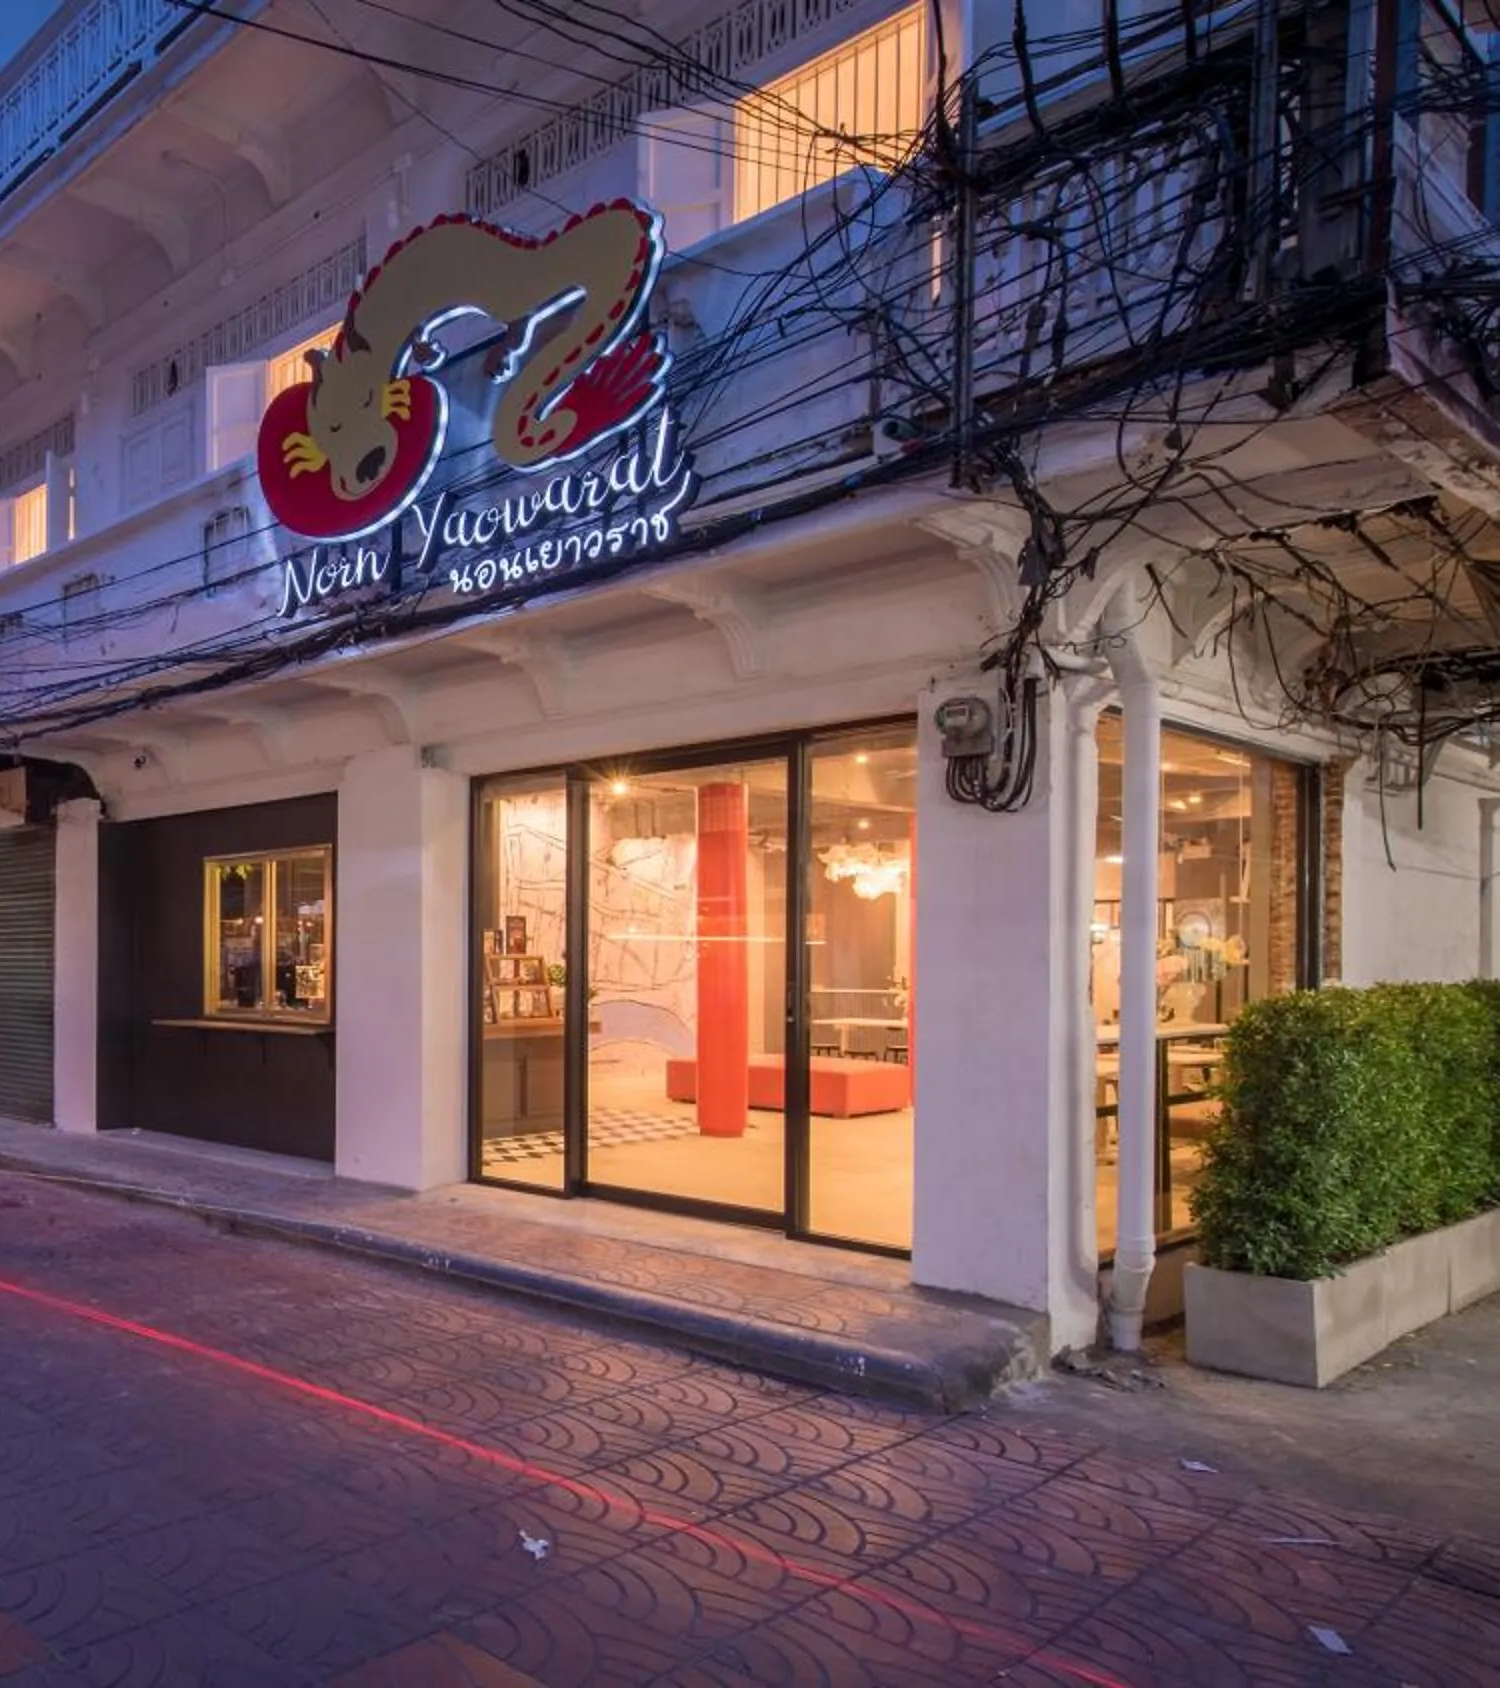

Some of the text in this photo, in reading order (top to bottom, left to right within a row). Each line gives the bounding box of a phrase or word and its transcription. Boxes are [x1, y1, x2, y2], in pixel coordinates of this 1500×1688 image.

[411, 405, 687, 573] Yaowarat
[449, 469, 692, 594] นอนเยาวราช
[276, 545, 392, 618] Norn
